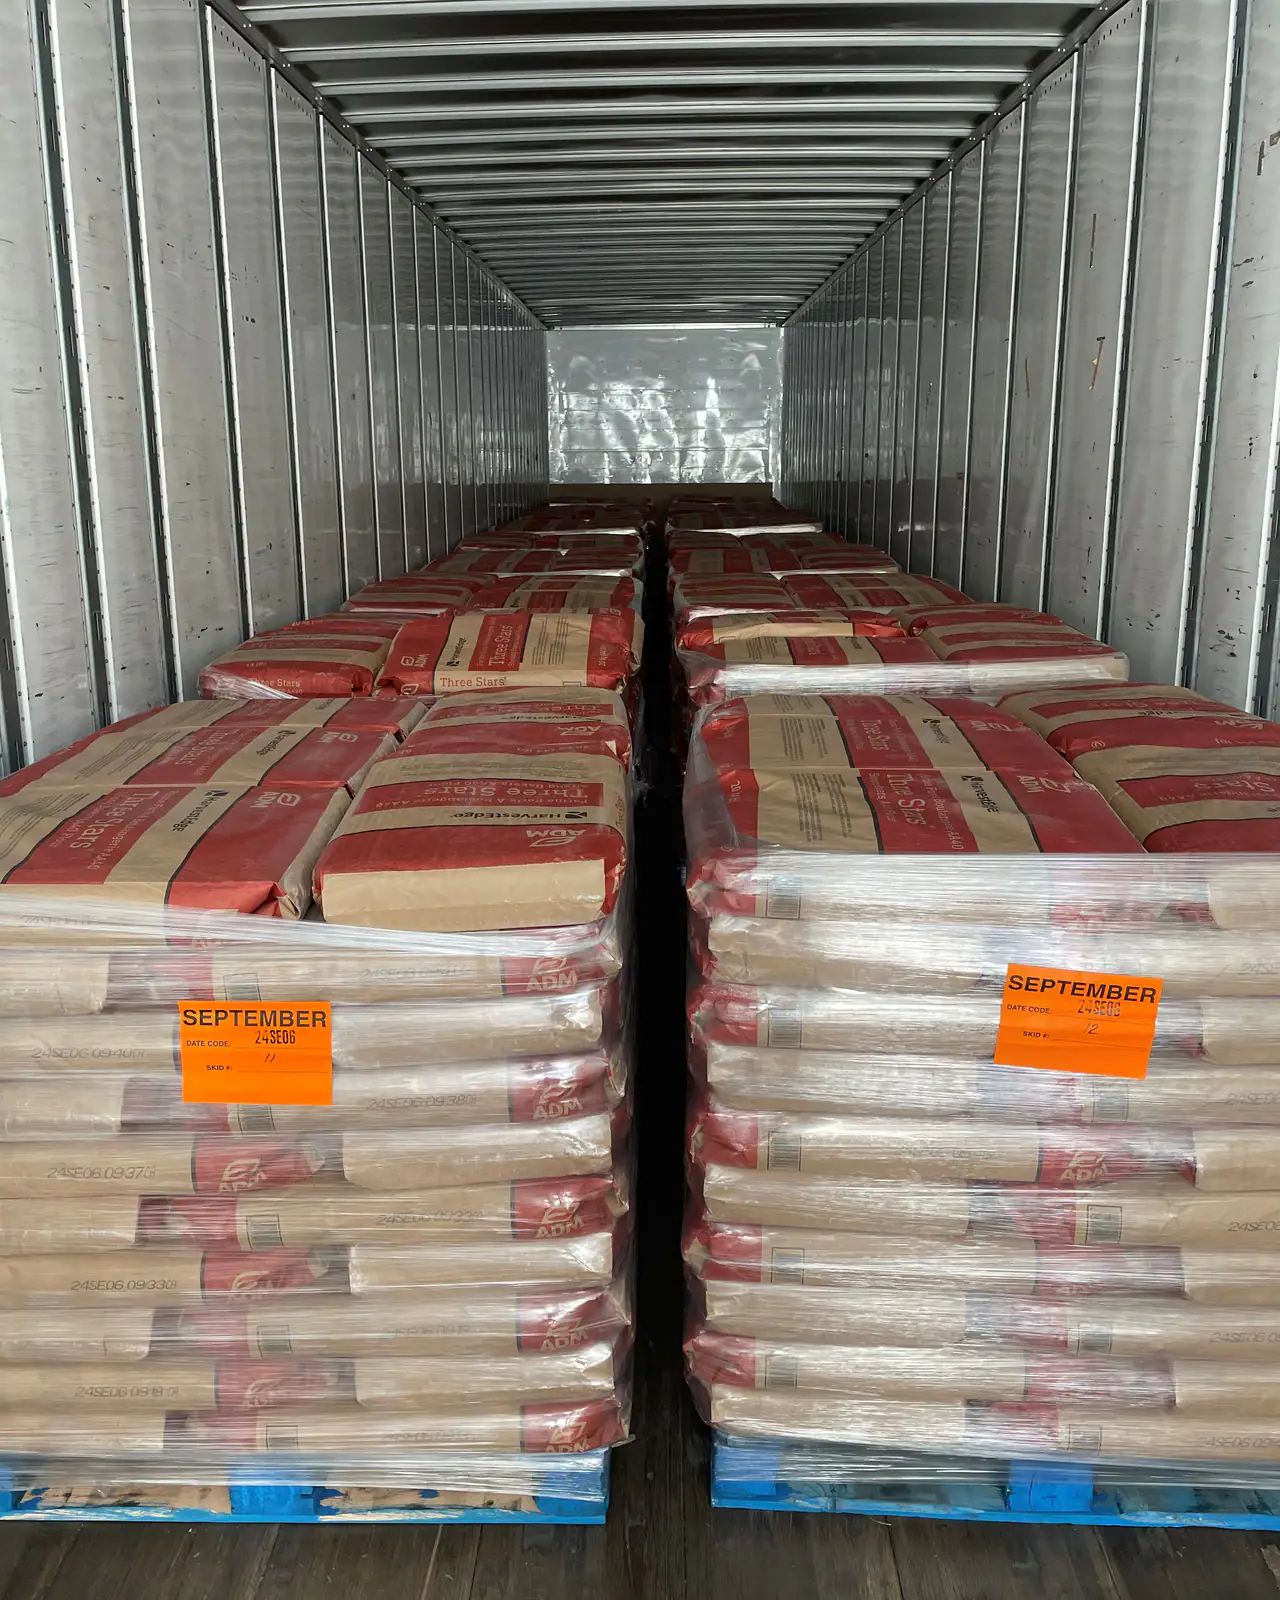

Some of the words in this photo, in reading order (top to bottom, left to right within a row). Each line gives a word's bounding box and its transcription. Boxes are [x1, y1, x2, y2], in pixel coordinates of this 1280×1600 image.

[494, 625, 513, 644] Stars
[488, 644, 508, 666] Three
[277, 678, 300, 688] Stars
[440, 677, 472, 688] Three
[476, 677, 505, 688] Stars
[424, 786, 497, 797] Stars
[506, 788, 588, 798] Three
[1016, 775, 1044, 793] ADM
[105, 791, 160, 817] Three
[898, 798, 927, 825] Stars
[453, 811, 561, 820] HarvestEdge
[70, 816, 123, 849] Stars
[526, 829, 586, 838] ADM
[526, 969, 578, 992] ADM
[1008, 974, 1158, 1004] SEPTEMBER
[1006, 1004, 1026, 1012] DATE
[183, 1009, 327, 1028] SEPTEMBER
[255, 1030, 296, 1044] 24SE06
[1022, 1030, 1041, 1038] SKID
[1083, 1022, 1100, 1036] 12
[533, 1098, 584, 1120] ADM
[47, 1166, 102, 1178] 24SE06
[535, 1216, 584, 1239] ADM
[70, 1280, 124, 1290] 24SE06
[540, 1330, 589, 1351] ADM
